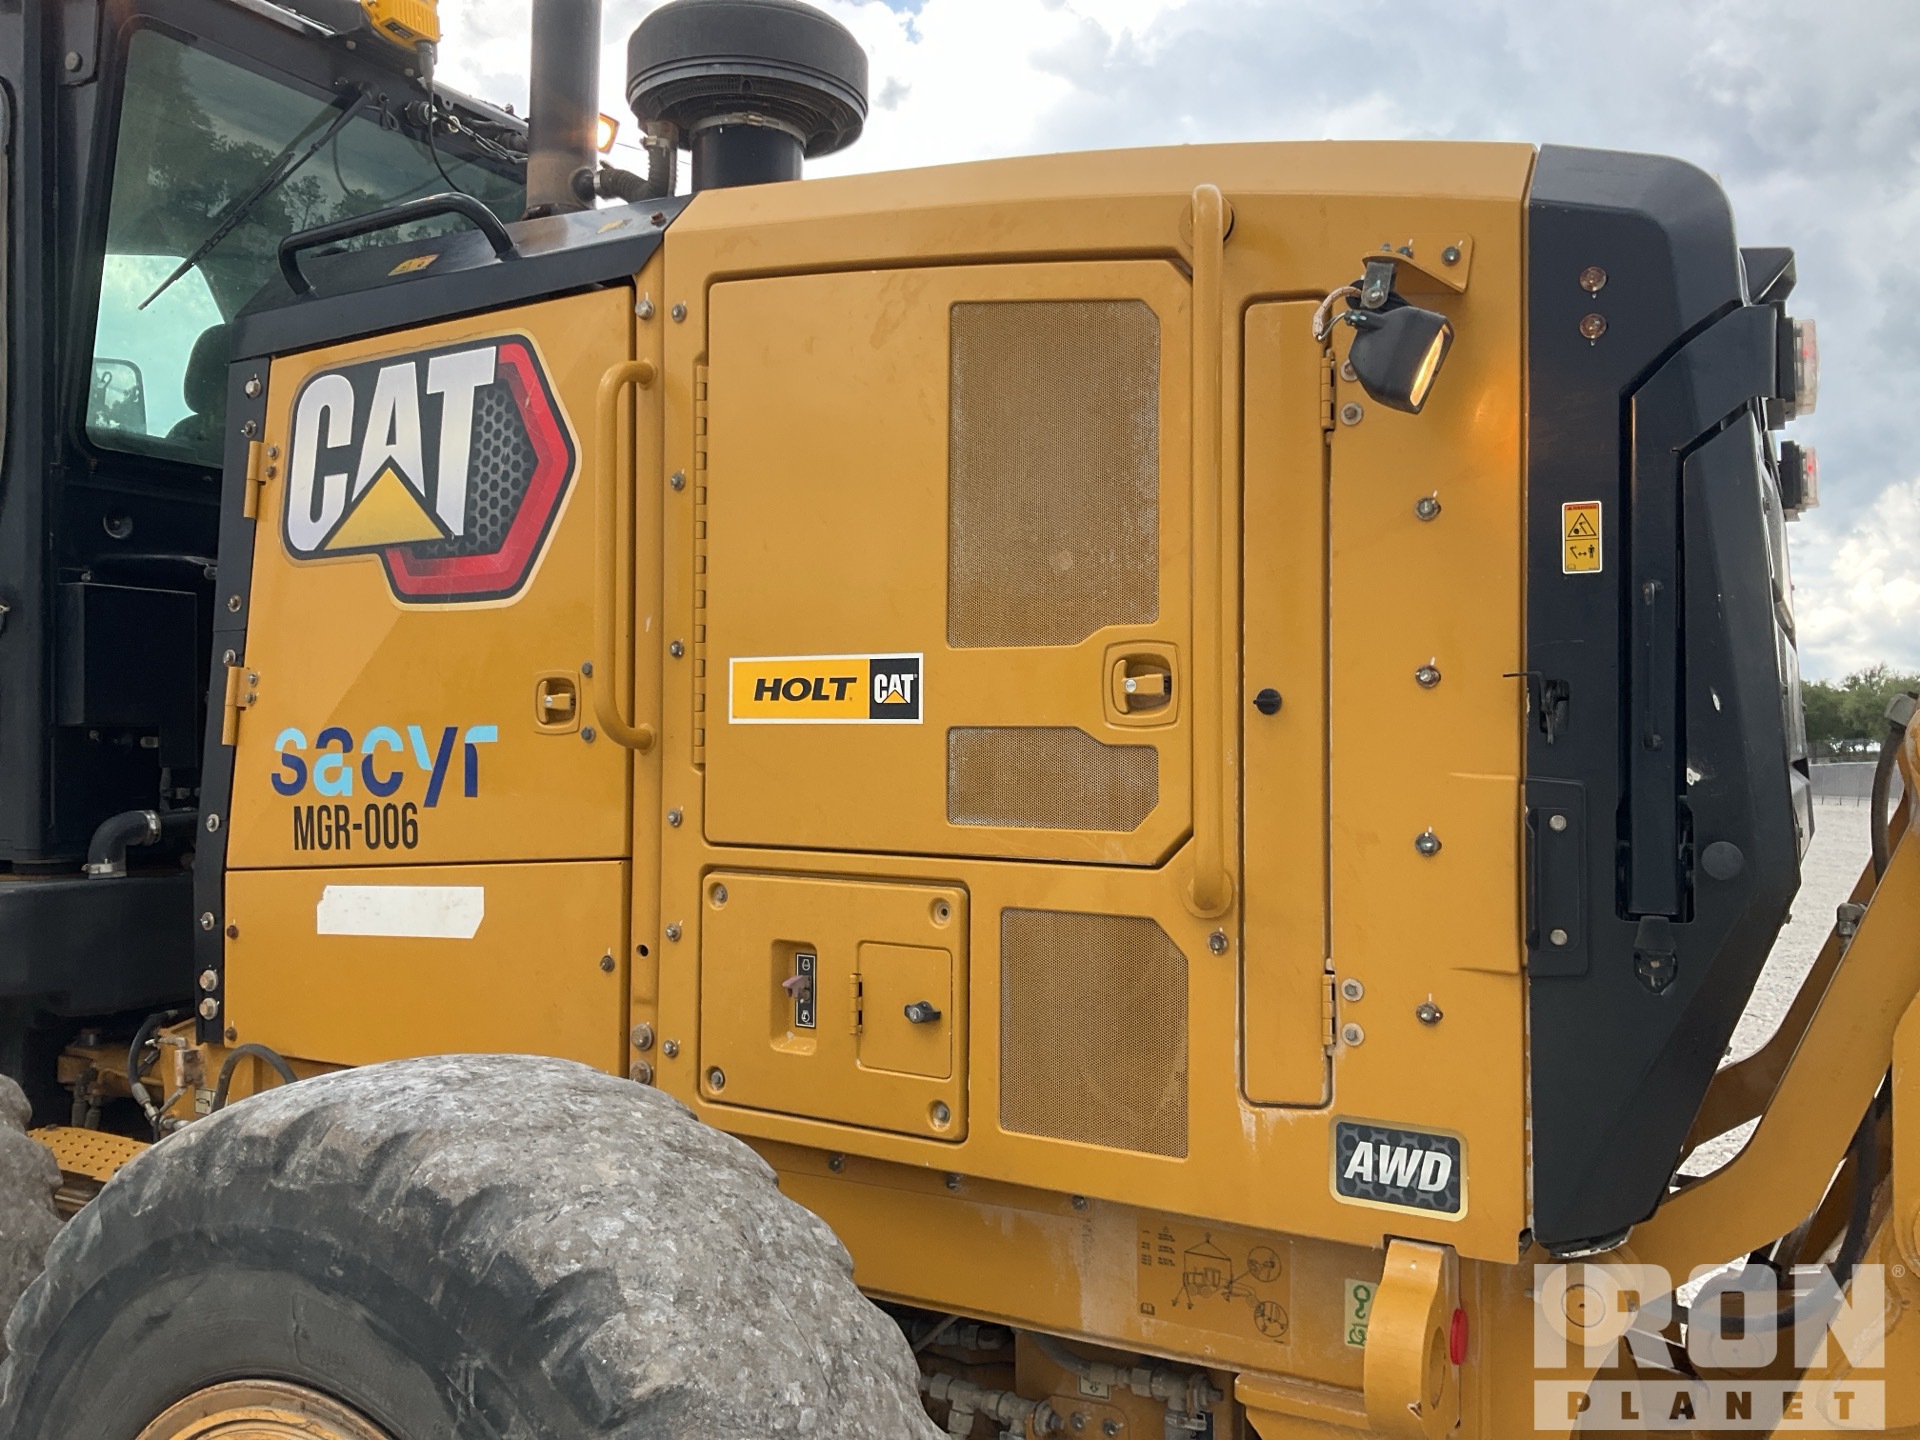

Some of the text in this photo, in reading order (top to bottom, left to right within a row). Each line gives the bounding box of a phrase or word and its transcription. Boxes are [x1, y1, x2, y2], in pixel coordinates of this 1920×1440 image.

[288, 346, 496, 551] CAT
[754, 673, 914, 703] HOLT CAT
[270, 724, 498, 807] sacyr
[294, 802, 418, 850] MGR-006
[1343, 1141, 1452, 1192] AWD
